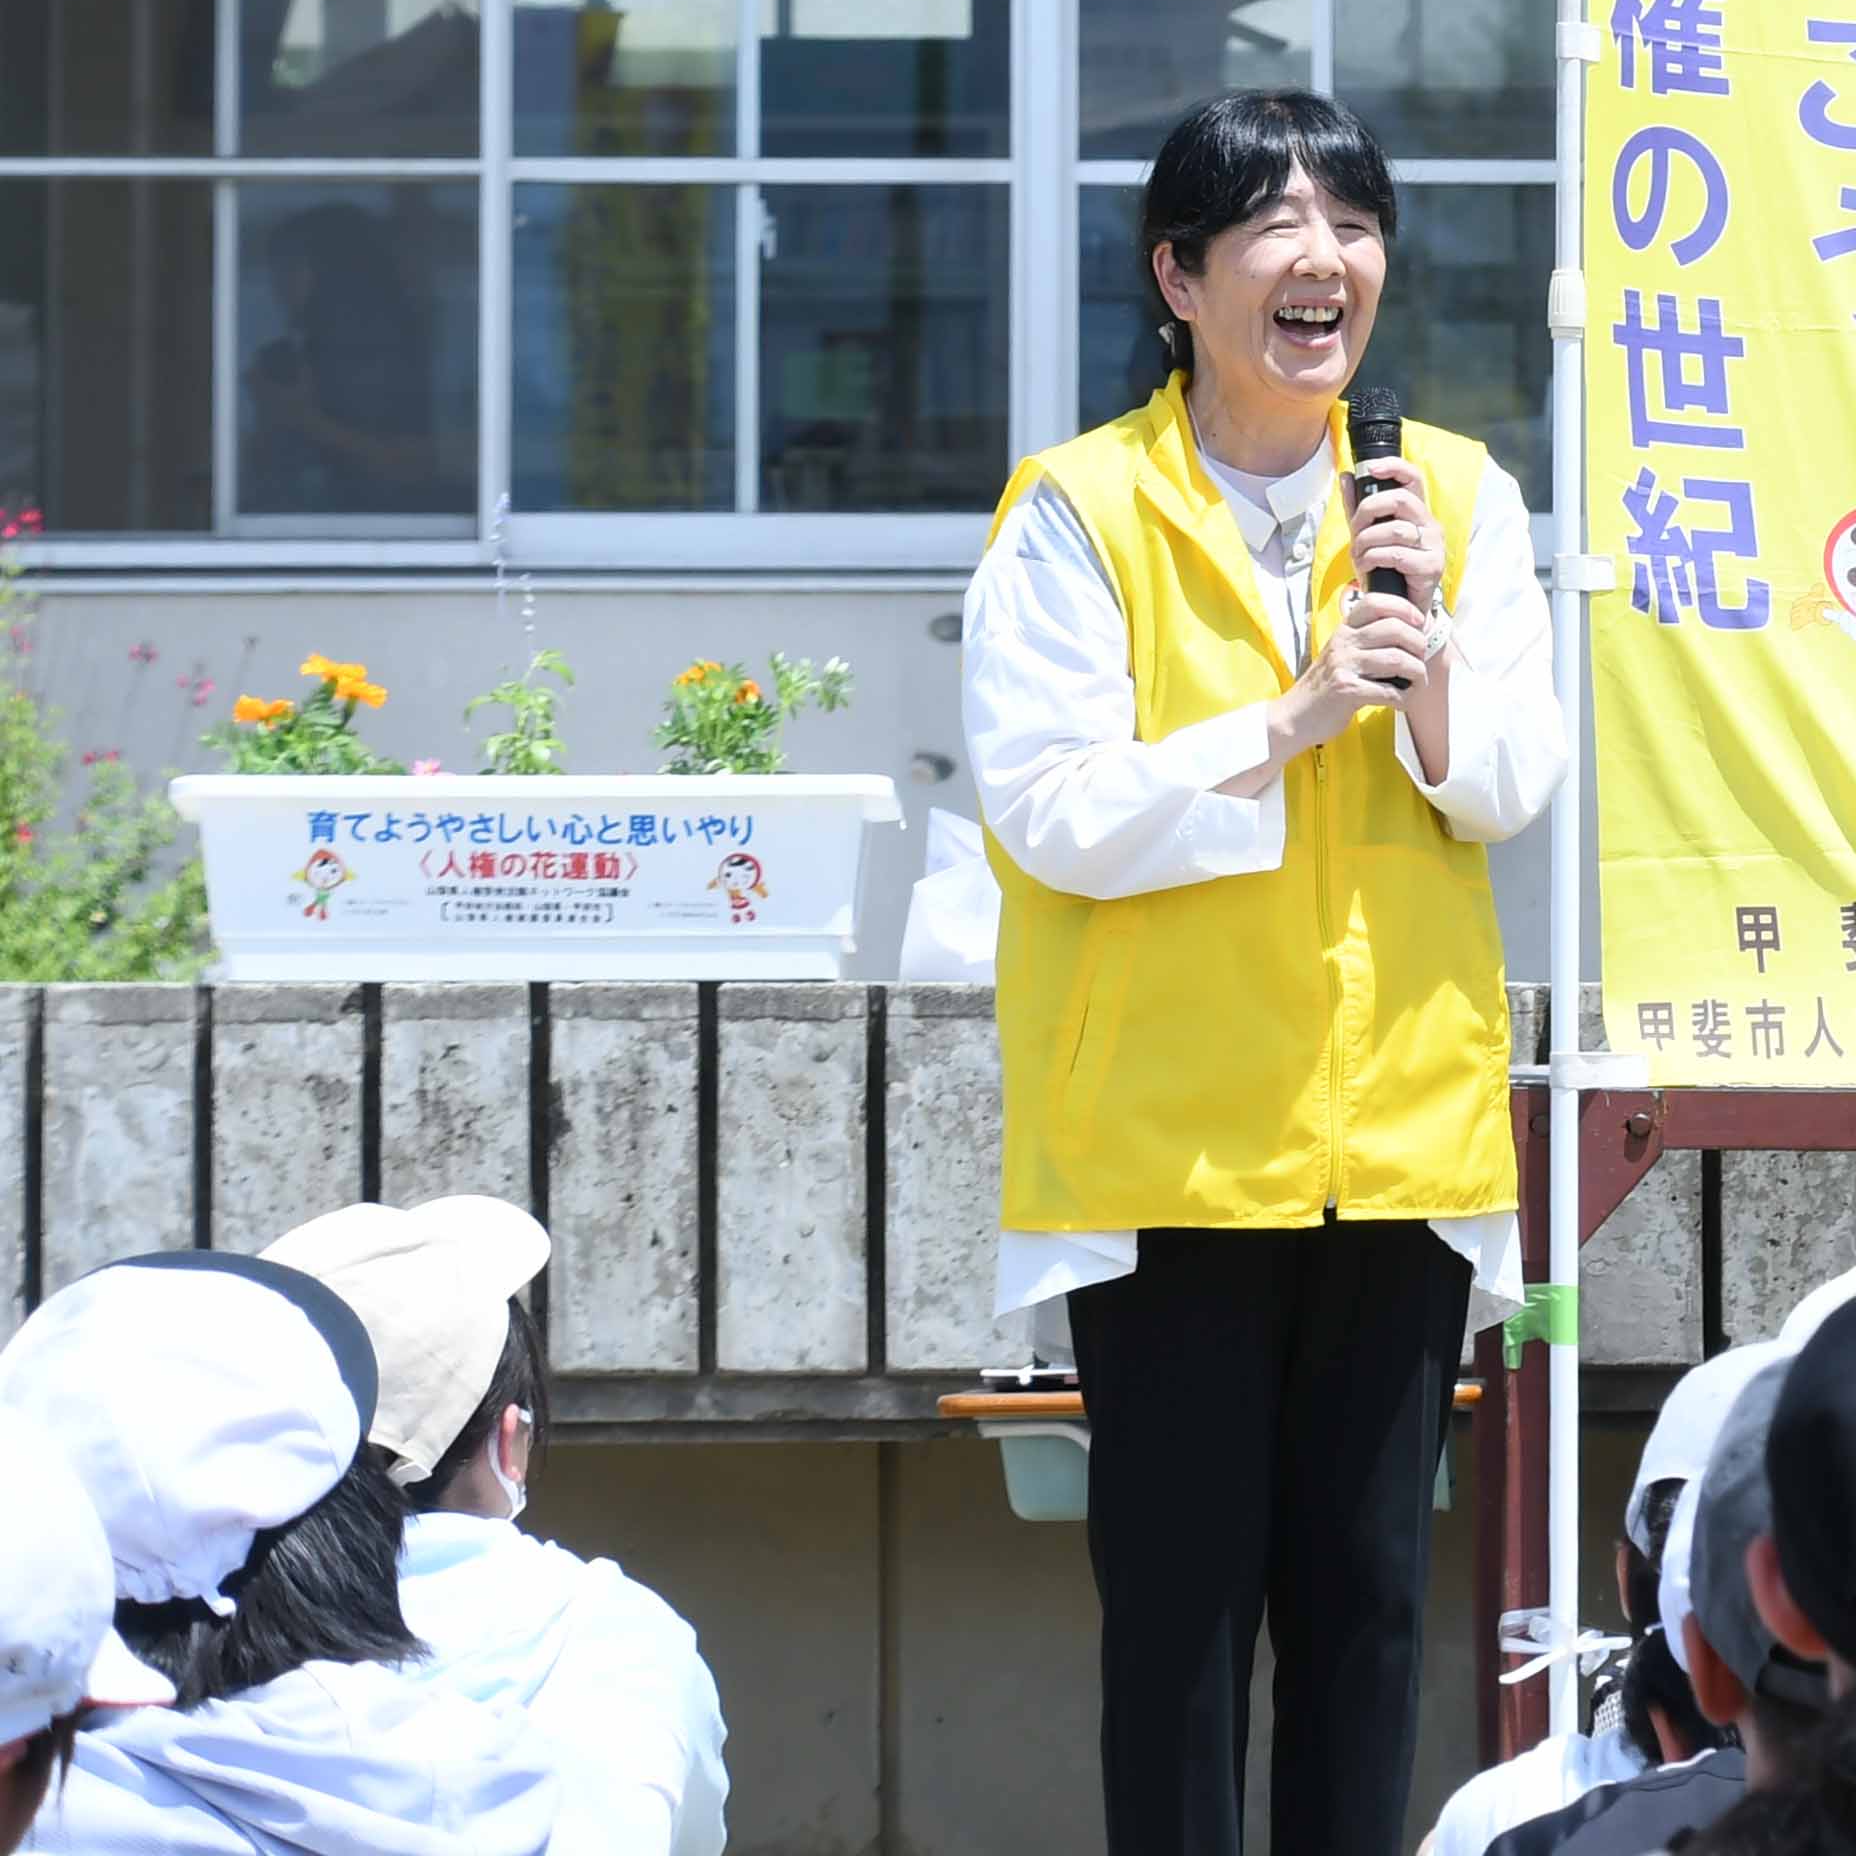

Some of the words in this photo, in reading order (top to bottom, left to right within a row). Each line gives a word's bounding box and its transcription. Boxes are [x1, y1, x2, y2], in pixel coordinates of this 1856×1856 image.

[306, 810, 754, 846] 育てようやさしい心と思いやり
